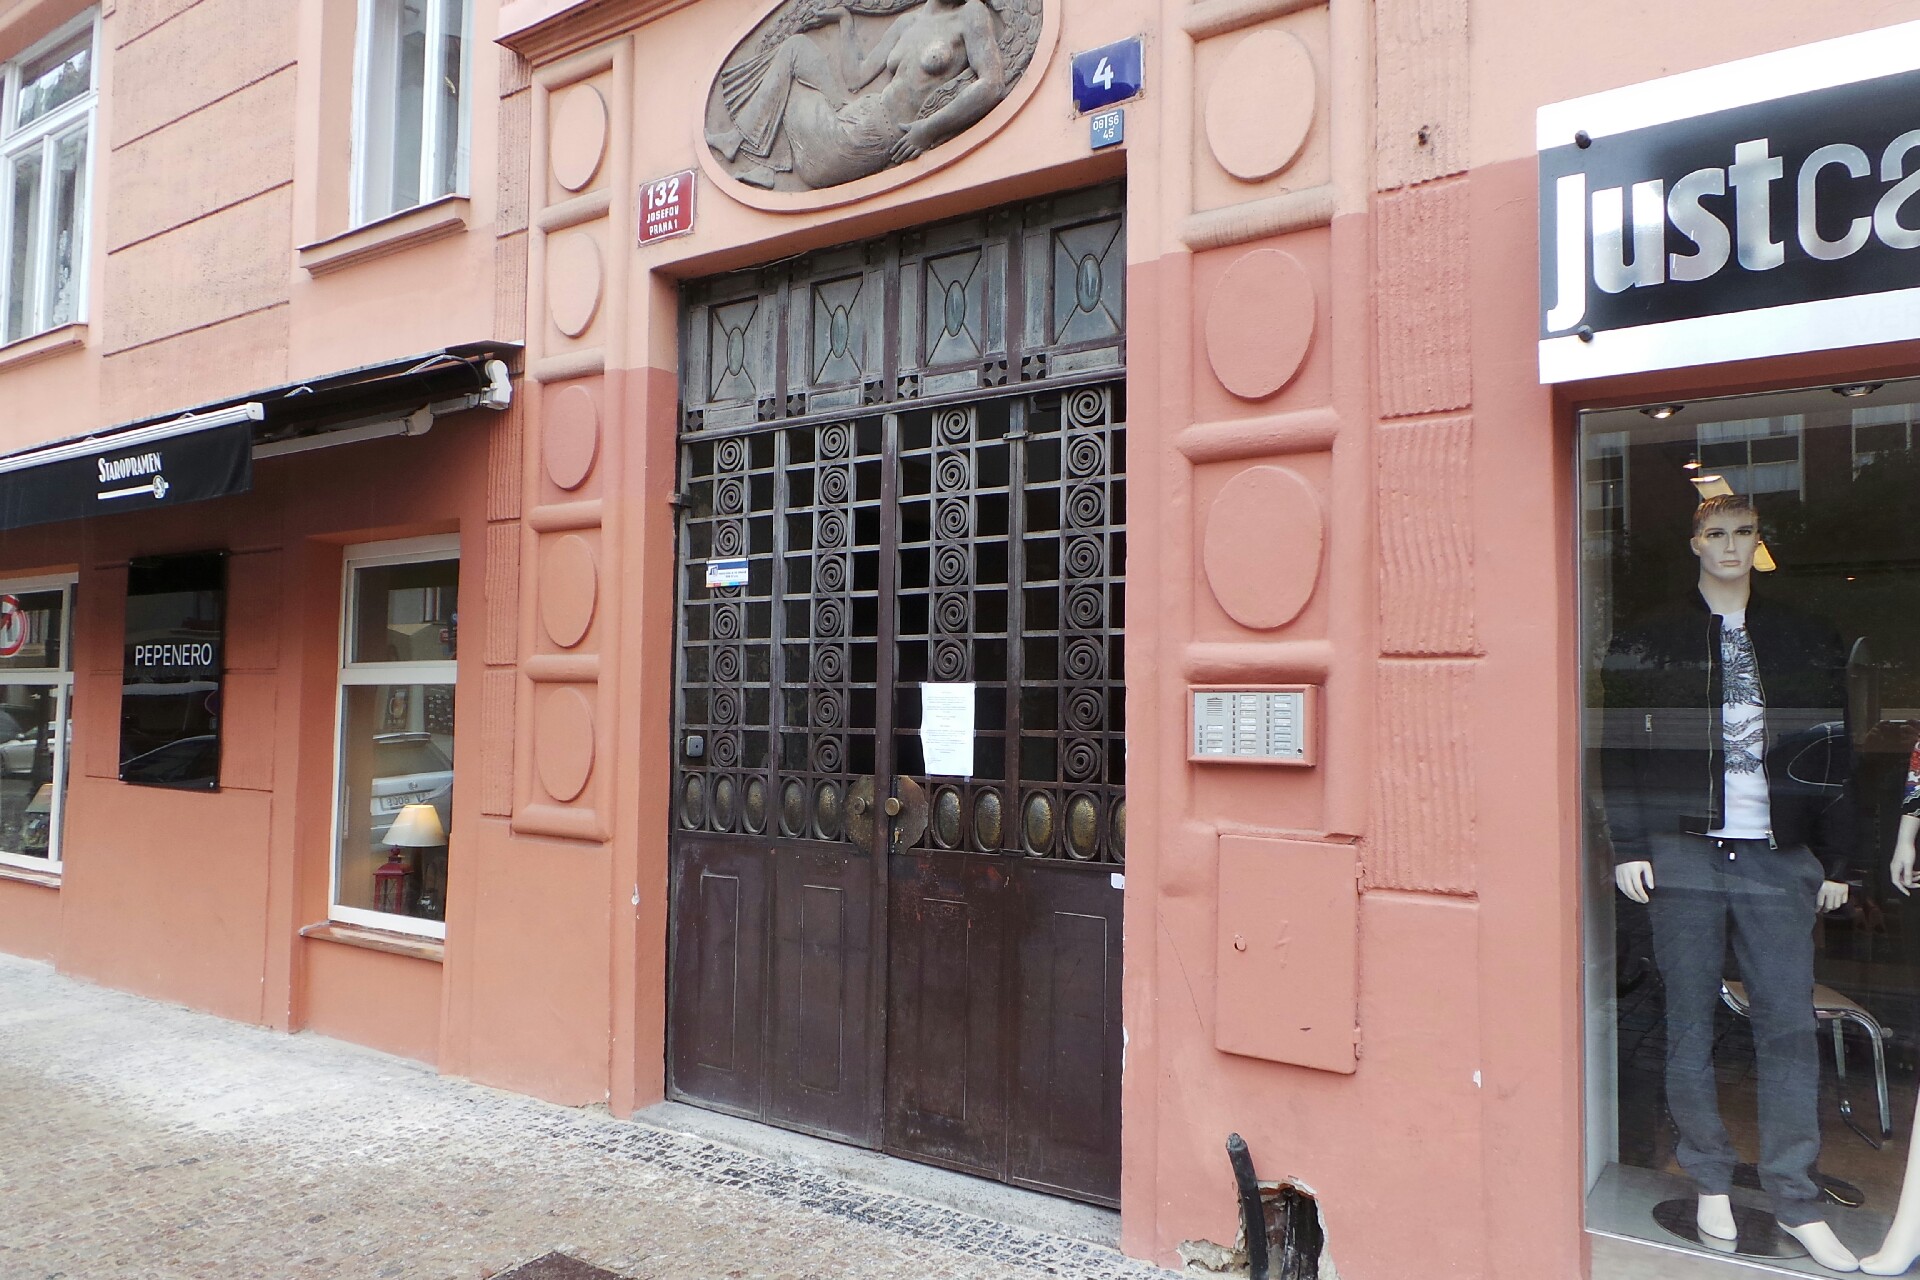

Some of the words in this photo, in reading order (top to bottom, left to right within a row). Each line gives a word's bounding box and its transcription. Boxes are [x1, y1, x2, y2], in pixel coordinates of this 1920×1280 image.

[1093, 57, 1113, 90] 4
[648, 178, 679, 209] 132
[647, 205, 679, 223] JOSEFOV
[649, 220, 673, 236] PRAHA
[674, 218, 678, 229] 1
[134, 642, 213, 666] PEPENERO
